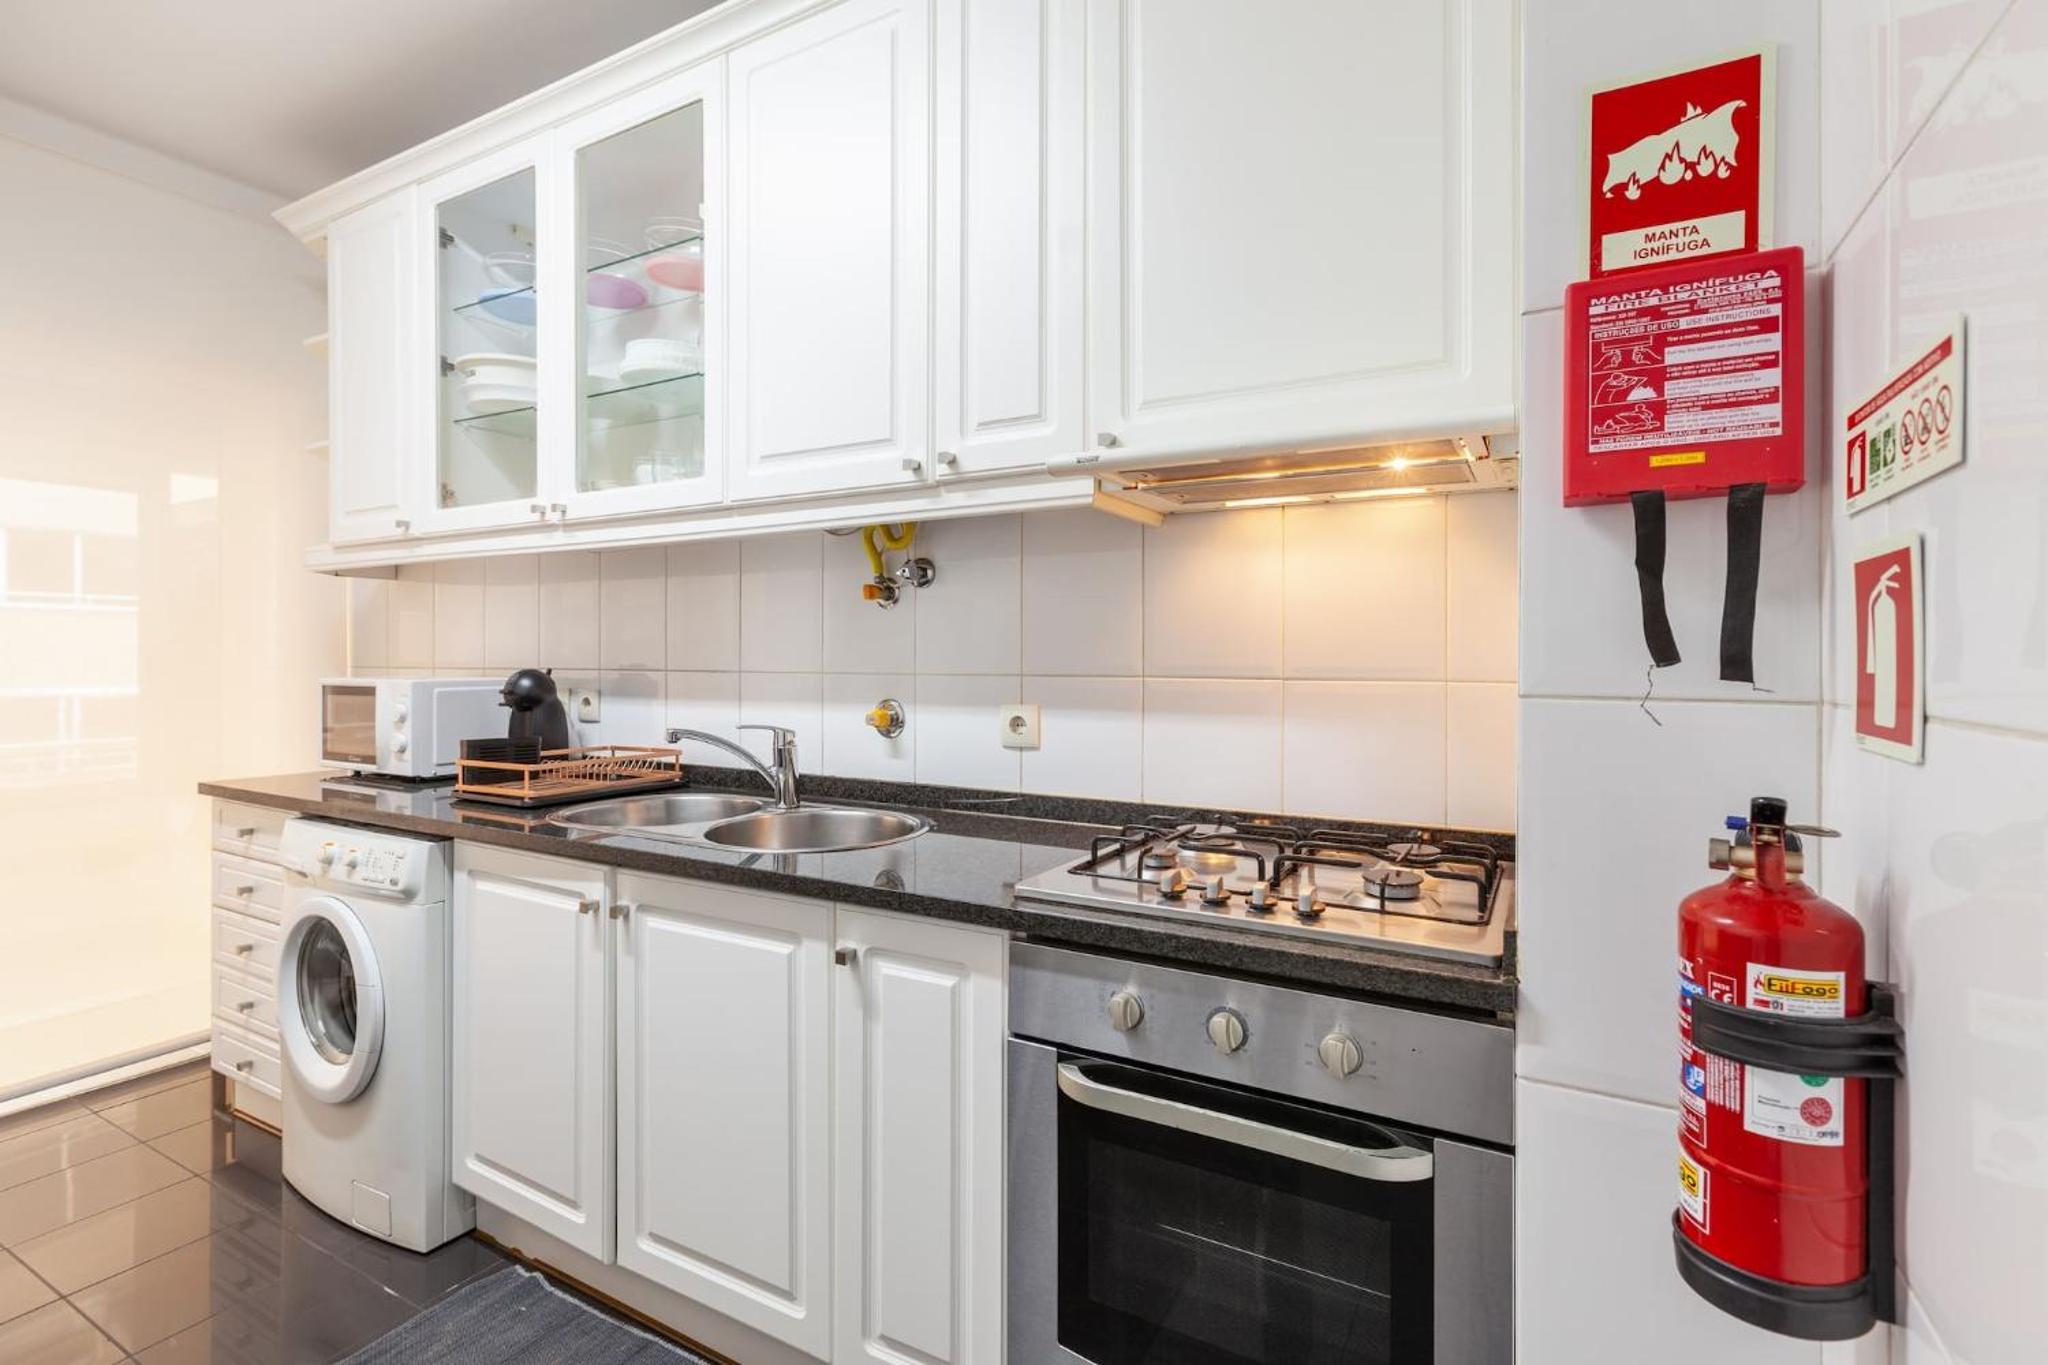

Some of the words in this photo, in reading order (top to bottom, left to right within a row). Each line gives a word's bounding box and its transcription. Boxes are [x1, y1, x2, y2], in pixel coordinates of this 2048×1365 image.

[1643, 224, 1700, 244] MANTA
[1633, 238, 1711, 260] IGNÍFUGA
[1590, 288, 1664, 306] MANTA
[1668, 269, 1779, 293] IGNÍFUGA
